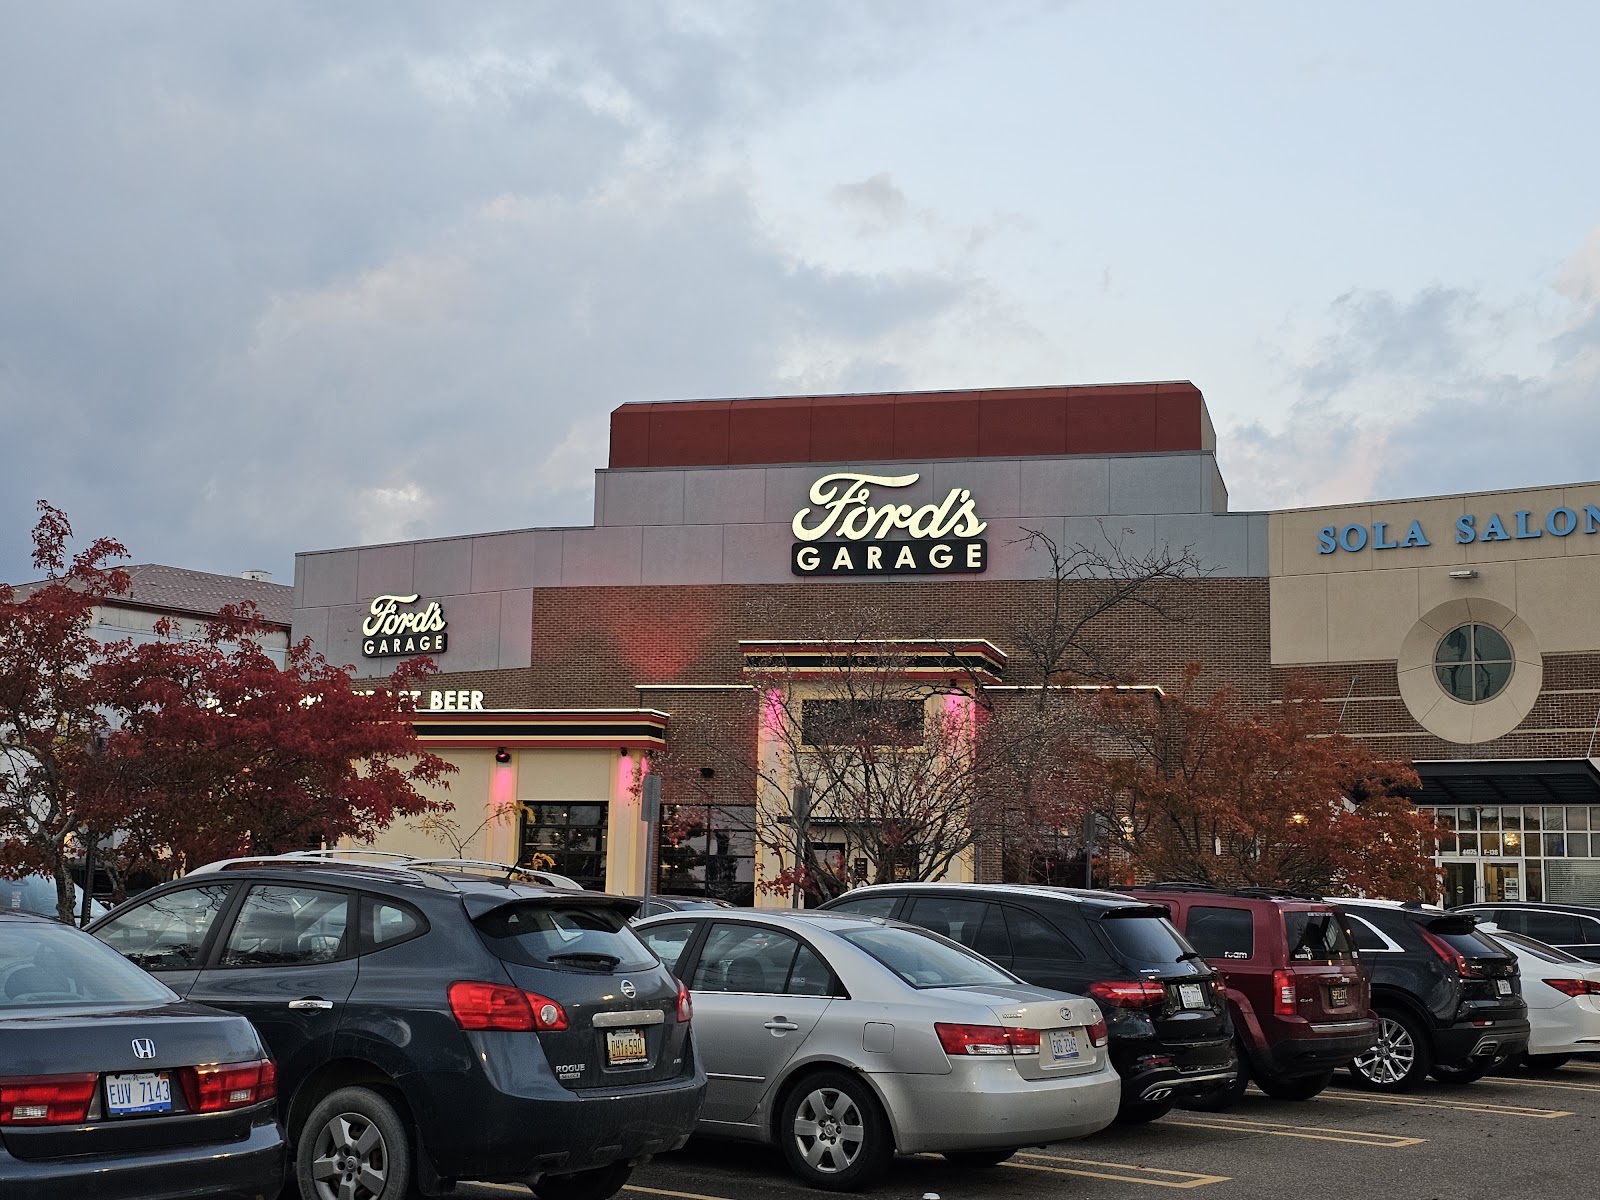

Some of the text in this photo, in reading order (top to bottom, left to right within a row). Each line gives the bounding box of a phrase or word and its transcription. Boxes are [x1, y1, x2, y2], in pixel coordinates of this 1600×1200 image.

[792, 473, 987, 541] Ford's
[1318, 519, 1430, 554] SOLA
[797, 544, 982, 571] GARAGE
[363, 594, 445, 637] Ford's
[364, 635, 443, 654] GARAGE
[430, 690, 484, 710] BEER
[628, 1039, 642, 1055] 590
[555, 1063, 586, 1073] ROGUE
[109, 1080, 170, 1105] EUV 7143
